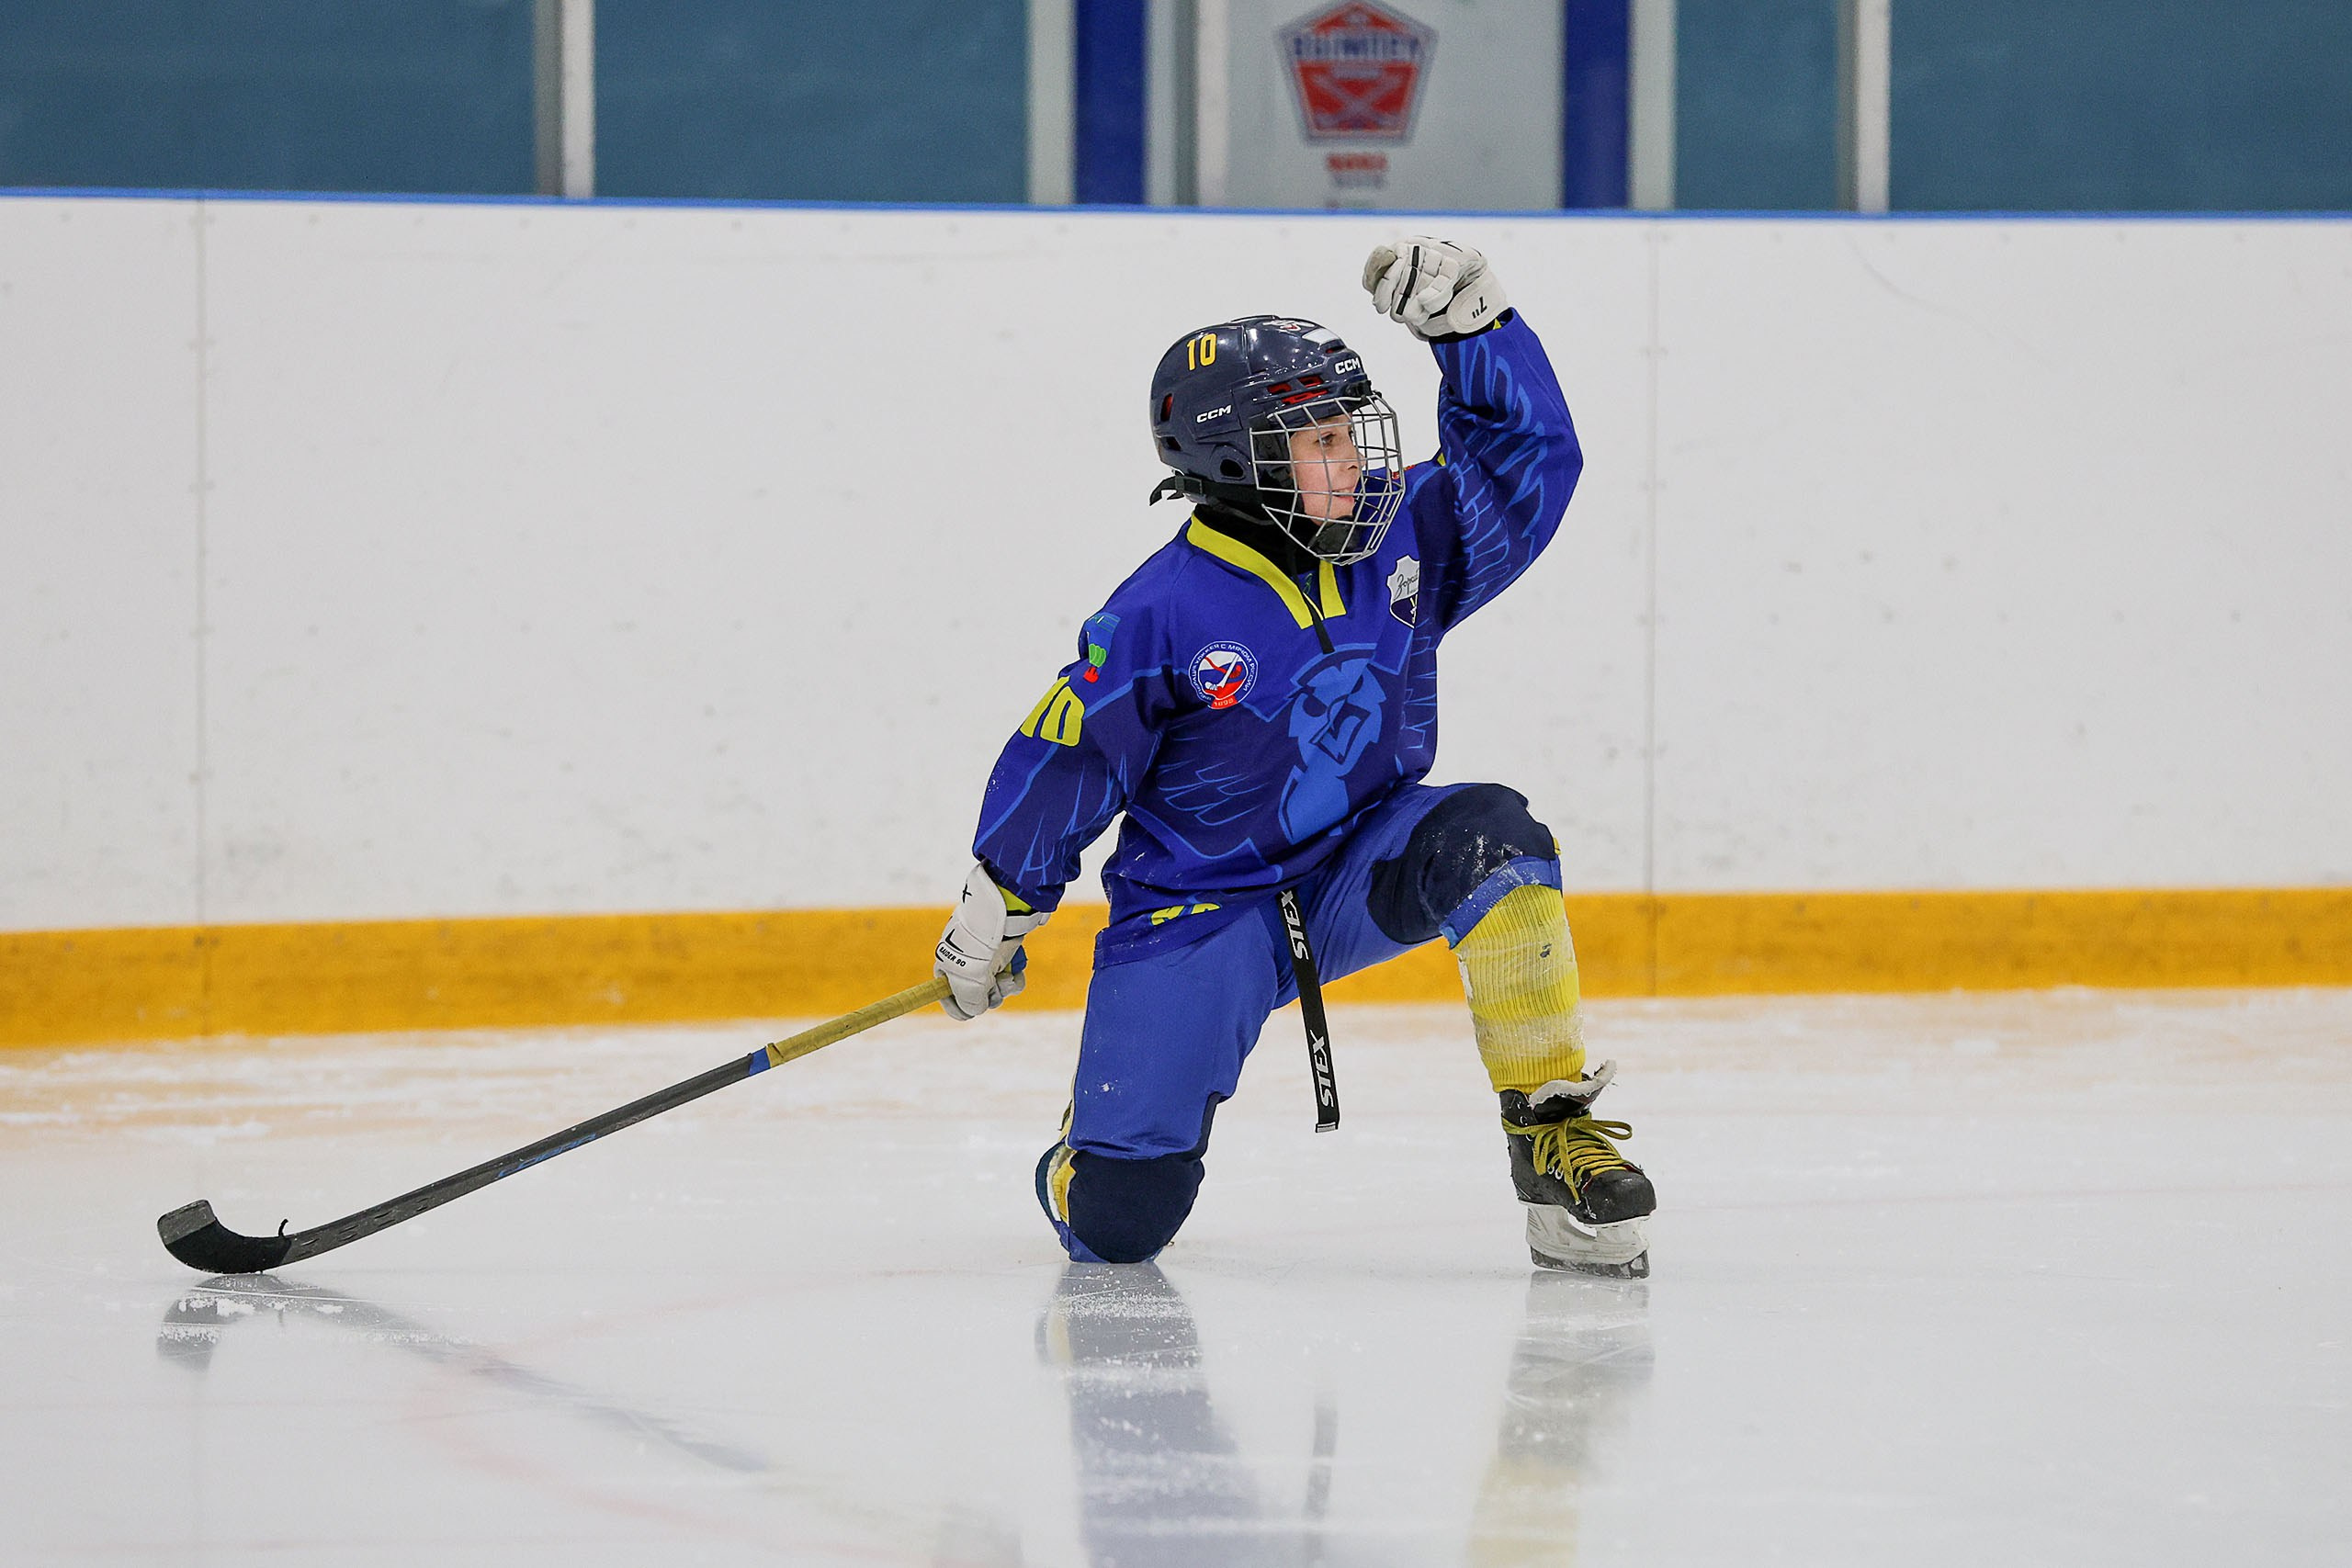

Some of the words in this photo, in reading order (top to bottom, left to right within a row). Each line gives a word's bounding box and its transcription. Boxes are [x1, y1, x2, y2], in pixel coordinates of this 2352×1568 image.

[1186, 333, 1216, 371] 10
[1334, 357, 1361, 375] CCM
[1196, 404, 1232, 423] CCM
[1019, 675, 1085, 747] 10
[1281, 890, 1309, 961] STEX
[1309, 1030, 1334, 1108] STEX
